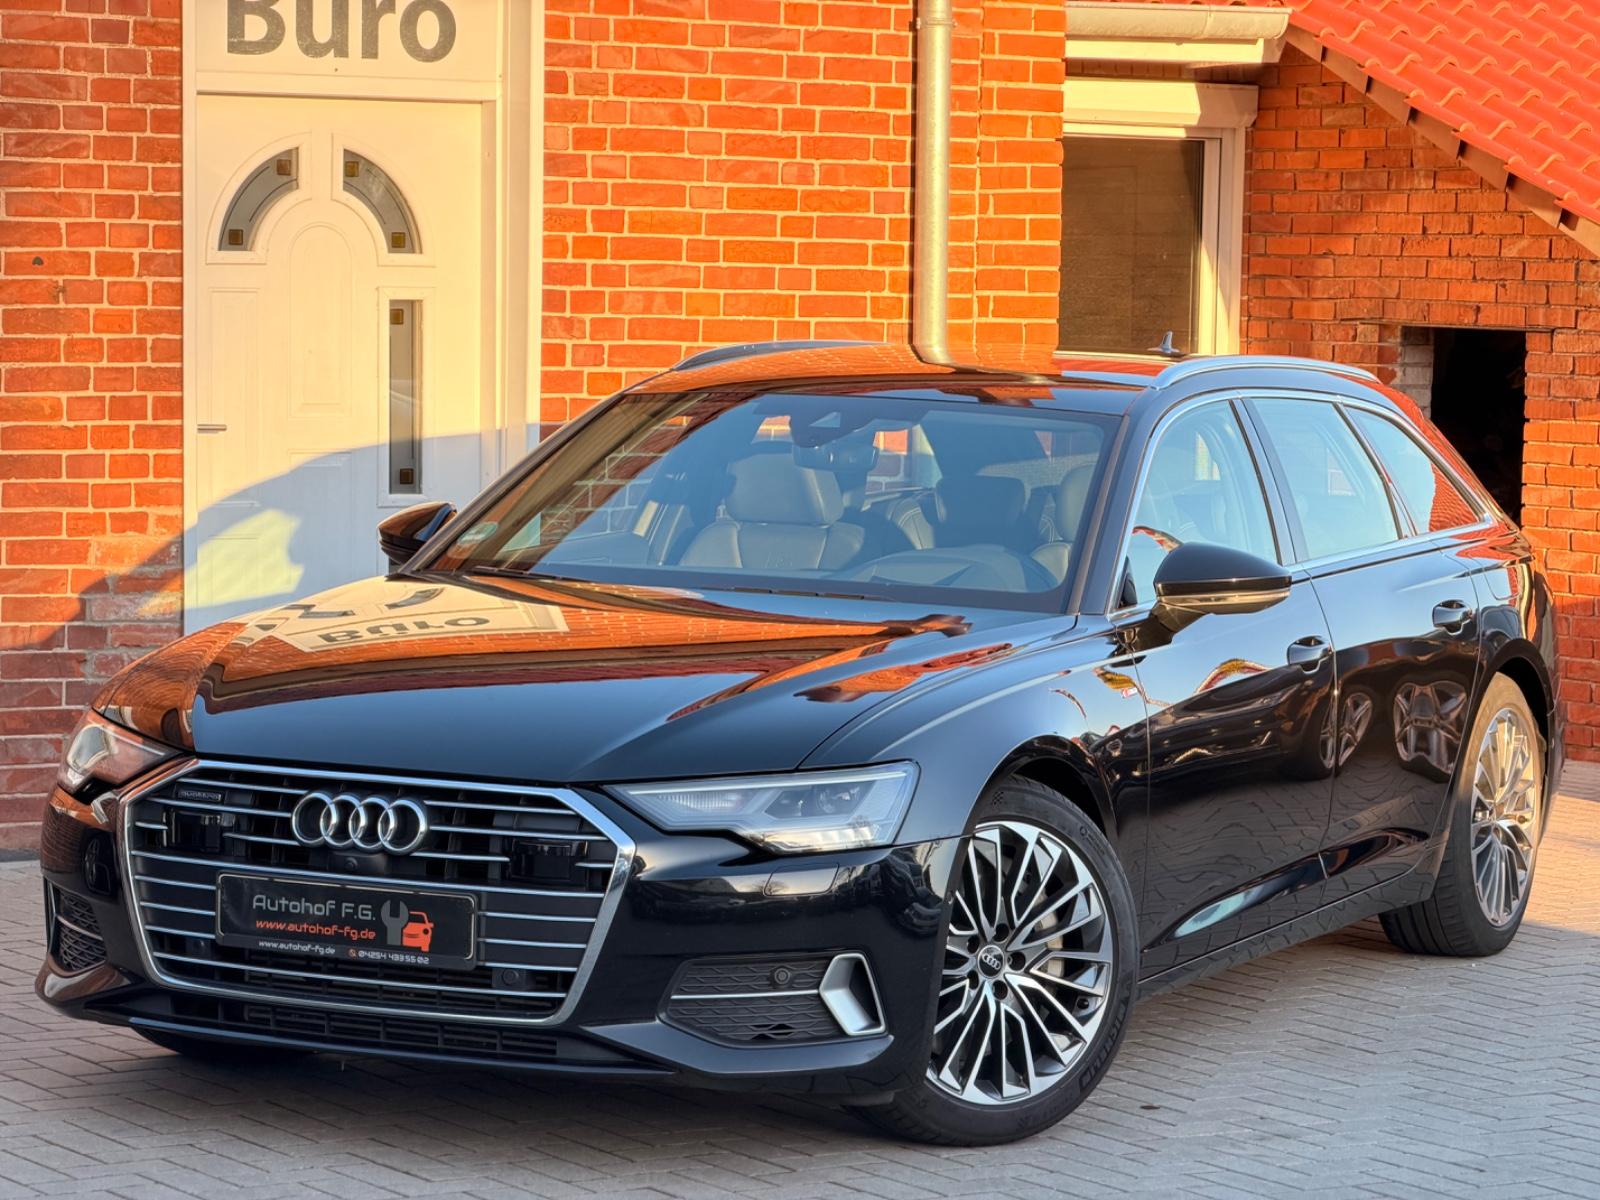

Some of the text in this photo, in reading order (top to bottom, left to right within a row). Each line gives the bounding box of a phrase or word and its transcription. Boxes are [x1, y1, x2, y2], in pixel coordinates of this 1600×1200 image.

[252, 894, 376, 921] Autohof F.G.
[255, 920, 376, 940] www.autohof-fg.de
[258, 940, 336, 955] www.autohof-fg.de
